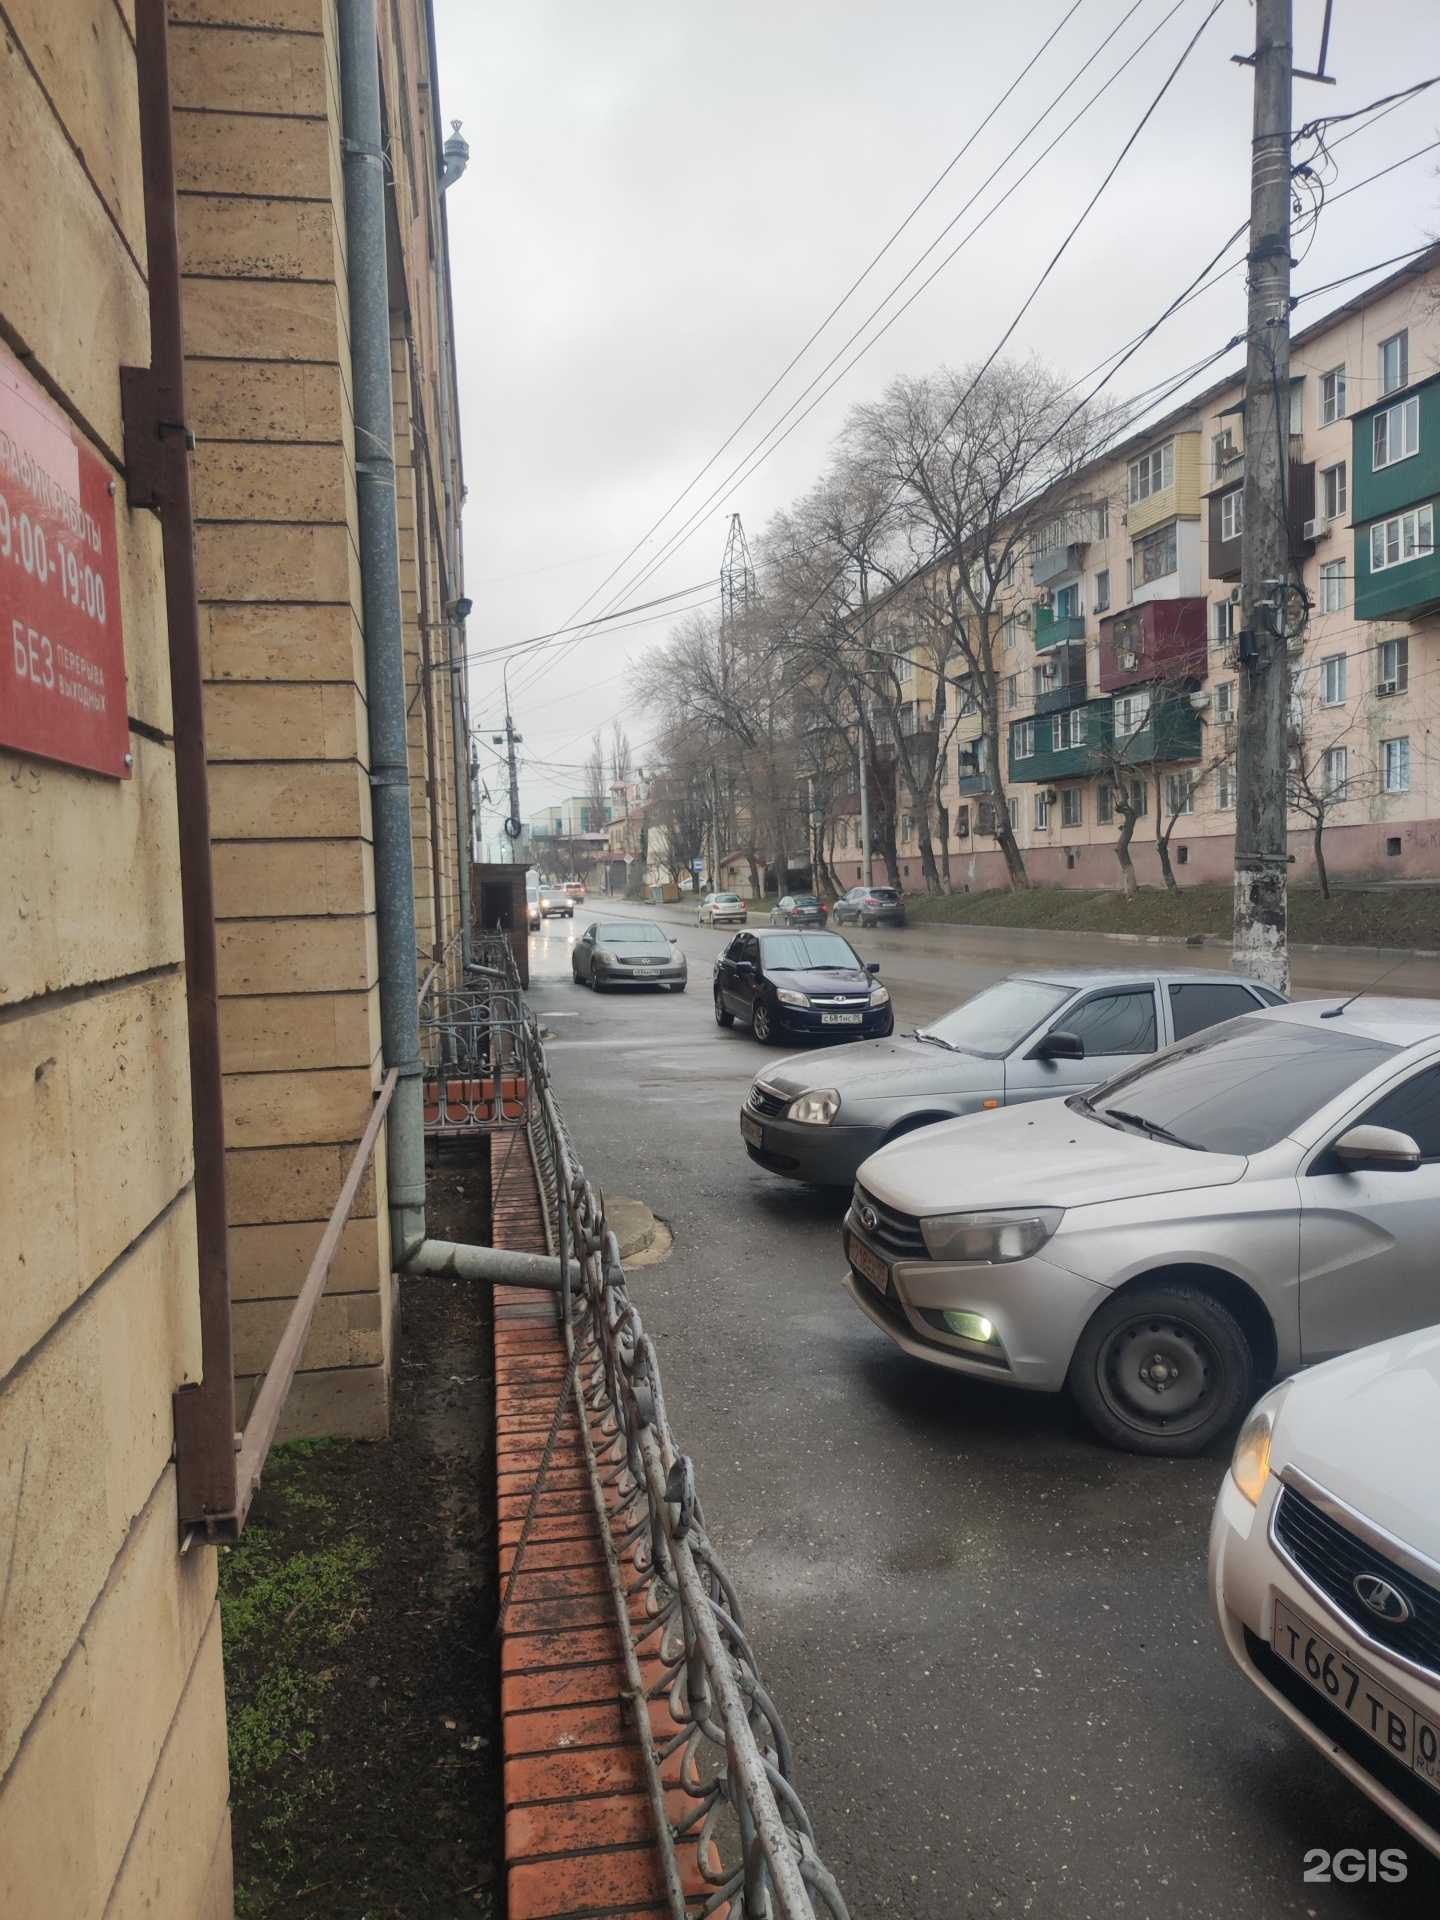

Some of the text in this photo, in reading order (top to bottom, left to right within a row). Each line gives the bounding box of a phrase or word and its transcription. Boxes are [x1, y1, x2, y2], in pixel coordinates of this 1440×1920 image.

[55, 482, 102, 556] РАБОТЫ
[12, 618, 54, 688] БЕЗ
[57, 644, 104, 688] ПЕРЕРЫВА
